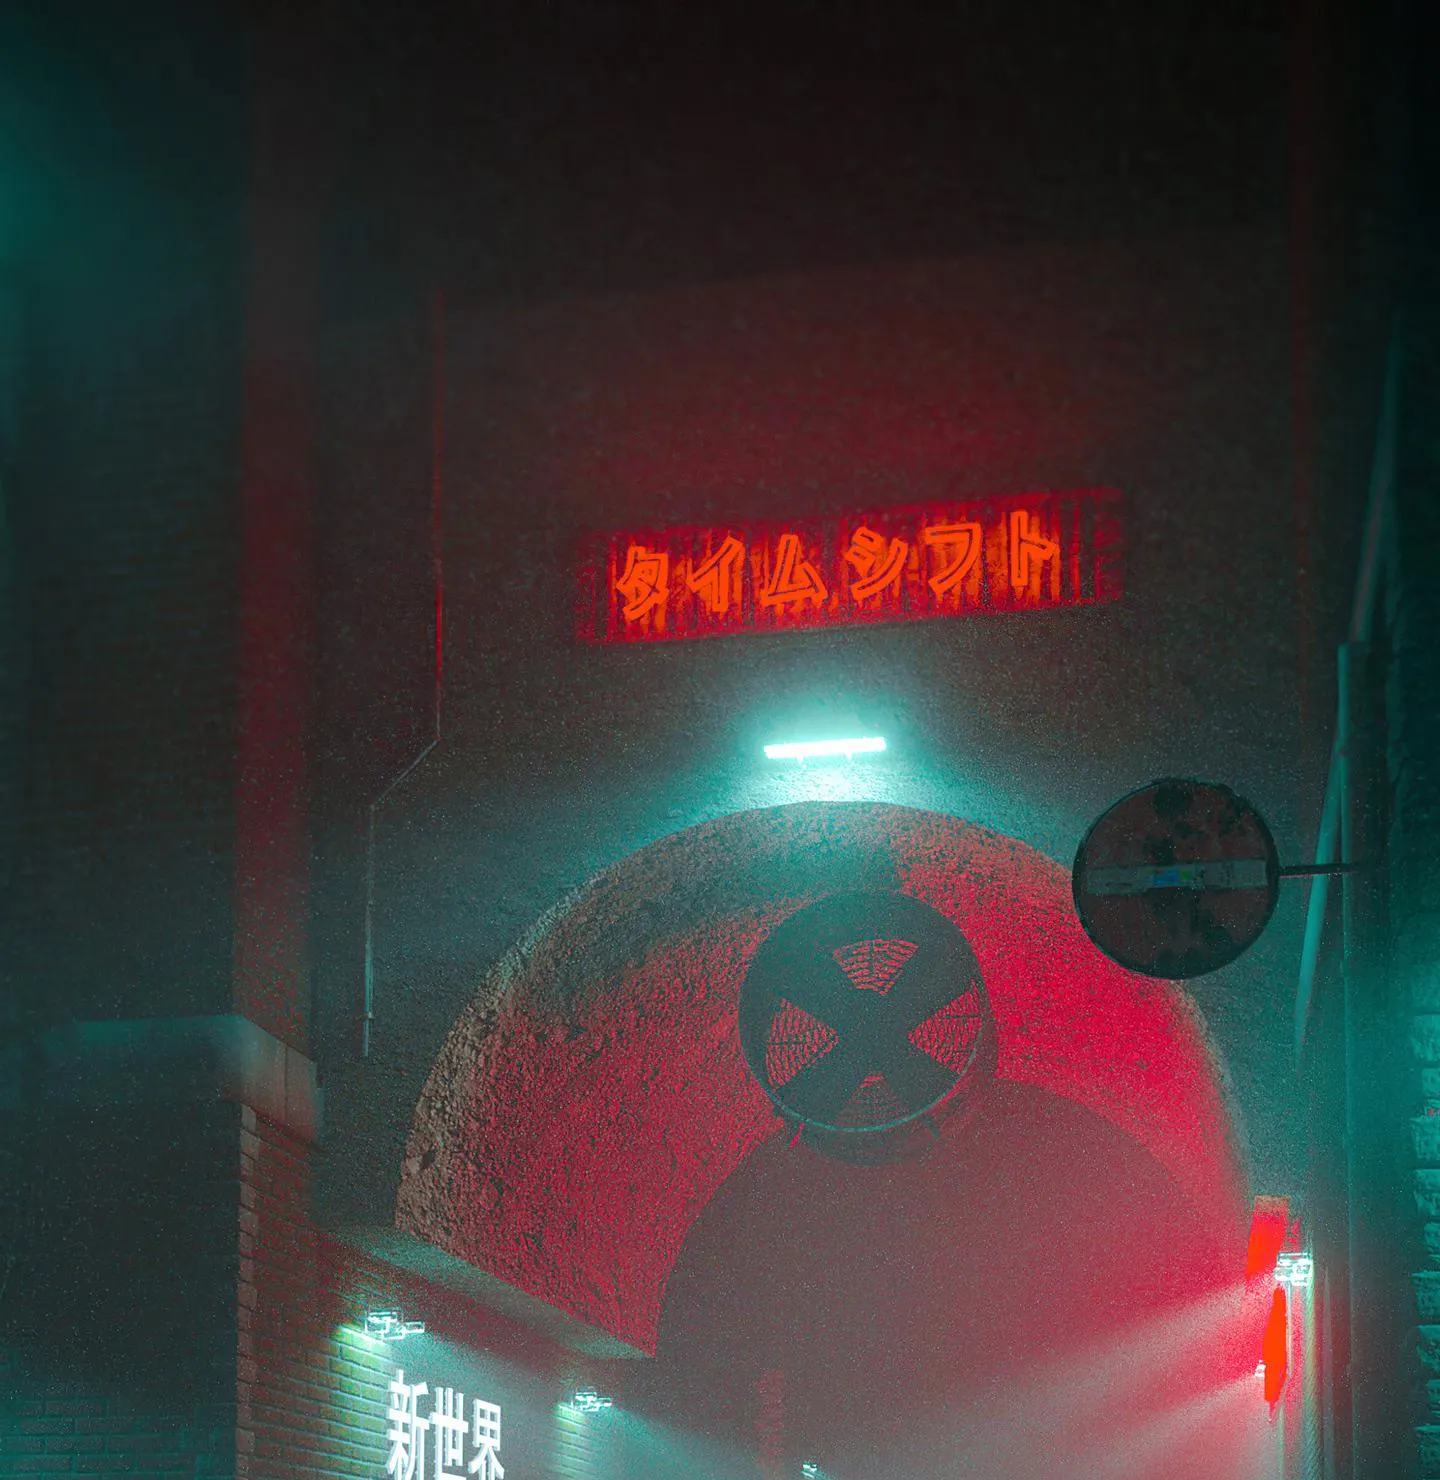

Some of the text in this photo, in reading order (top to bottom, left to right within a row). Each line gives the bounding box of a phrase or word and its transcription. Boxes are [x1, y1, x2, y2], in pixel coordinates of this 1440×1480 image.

[617, 510, 1057, 619] タイムシフト
